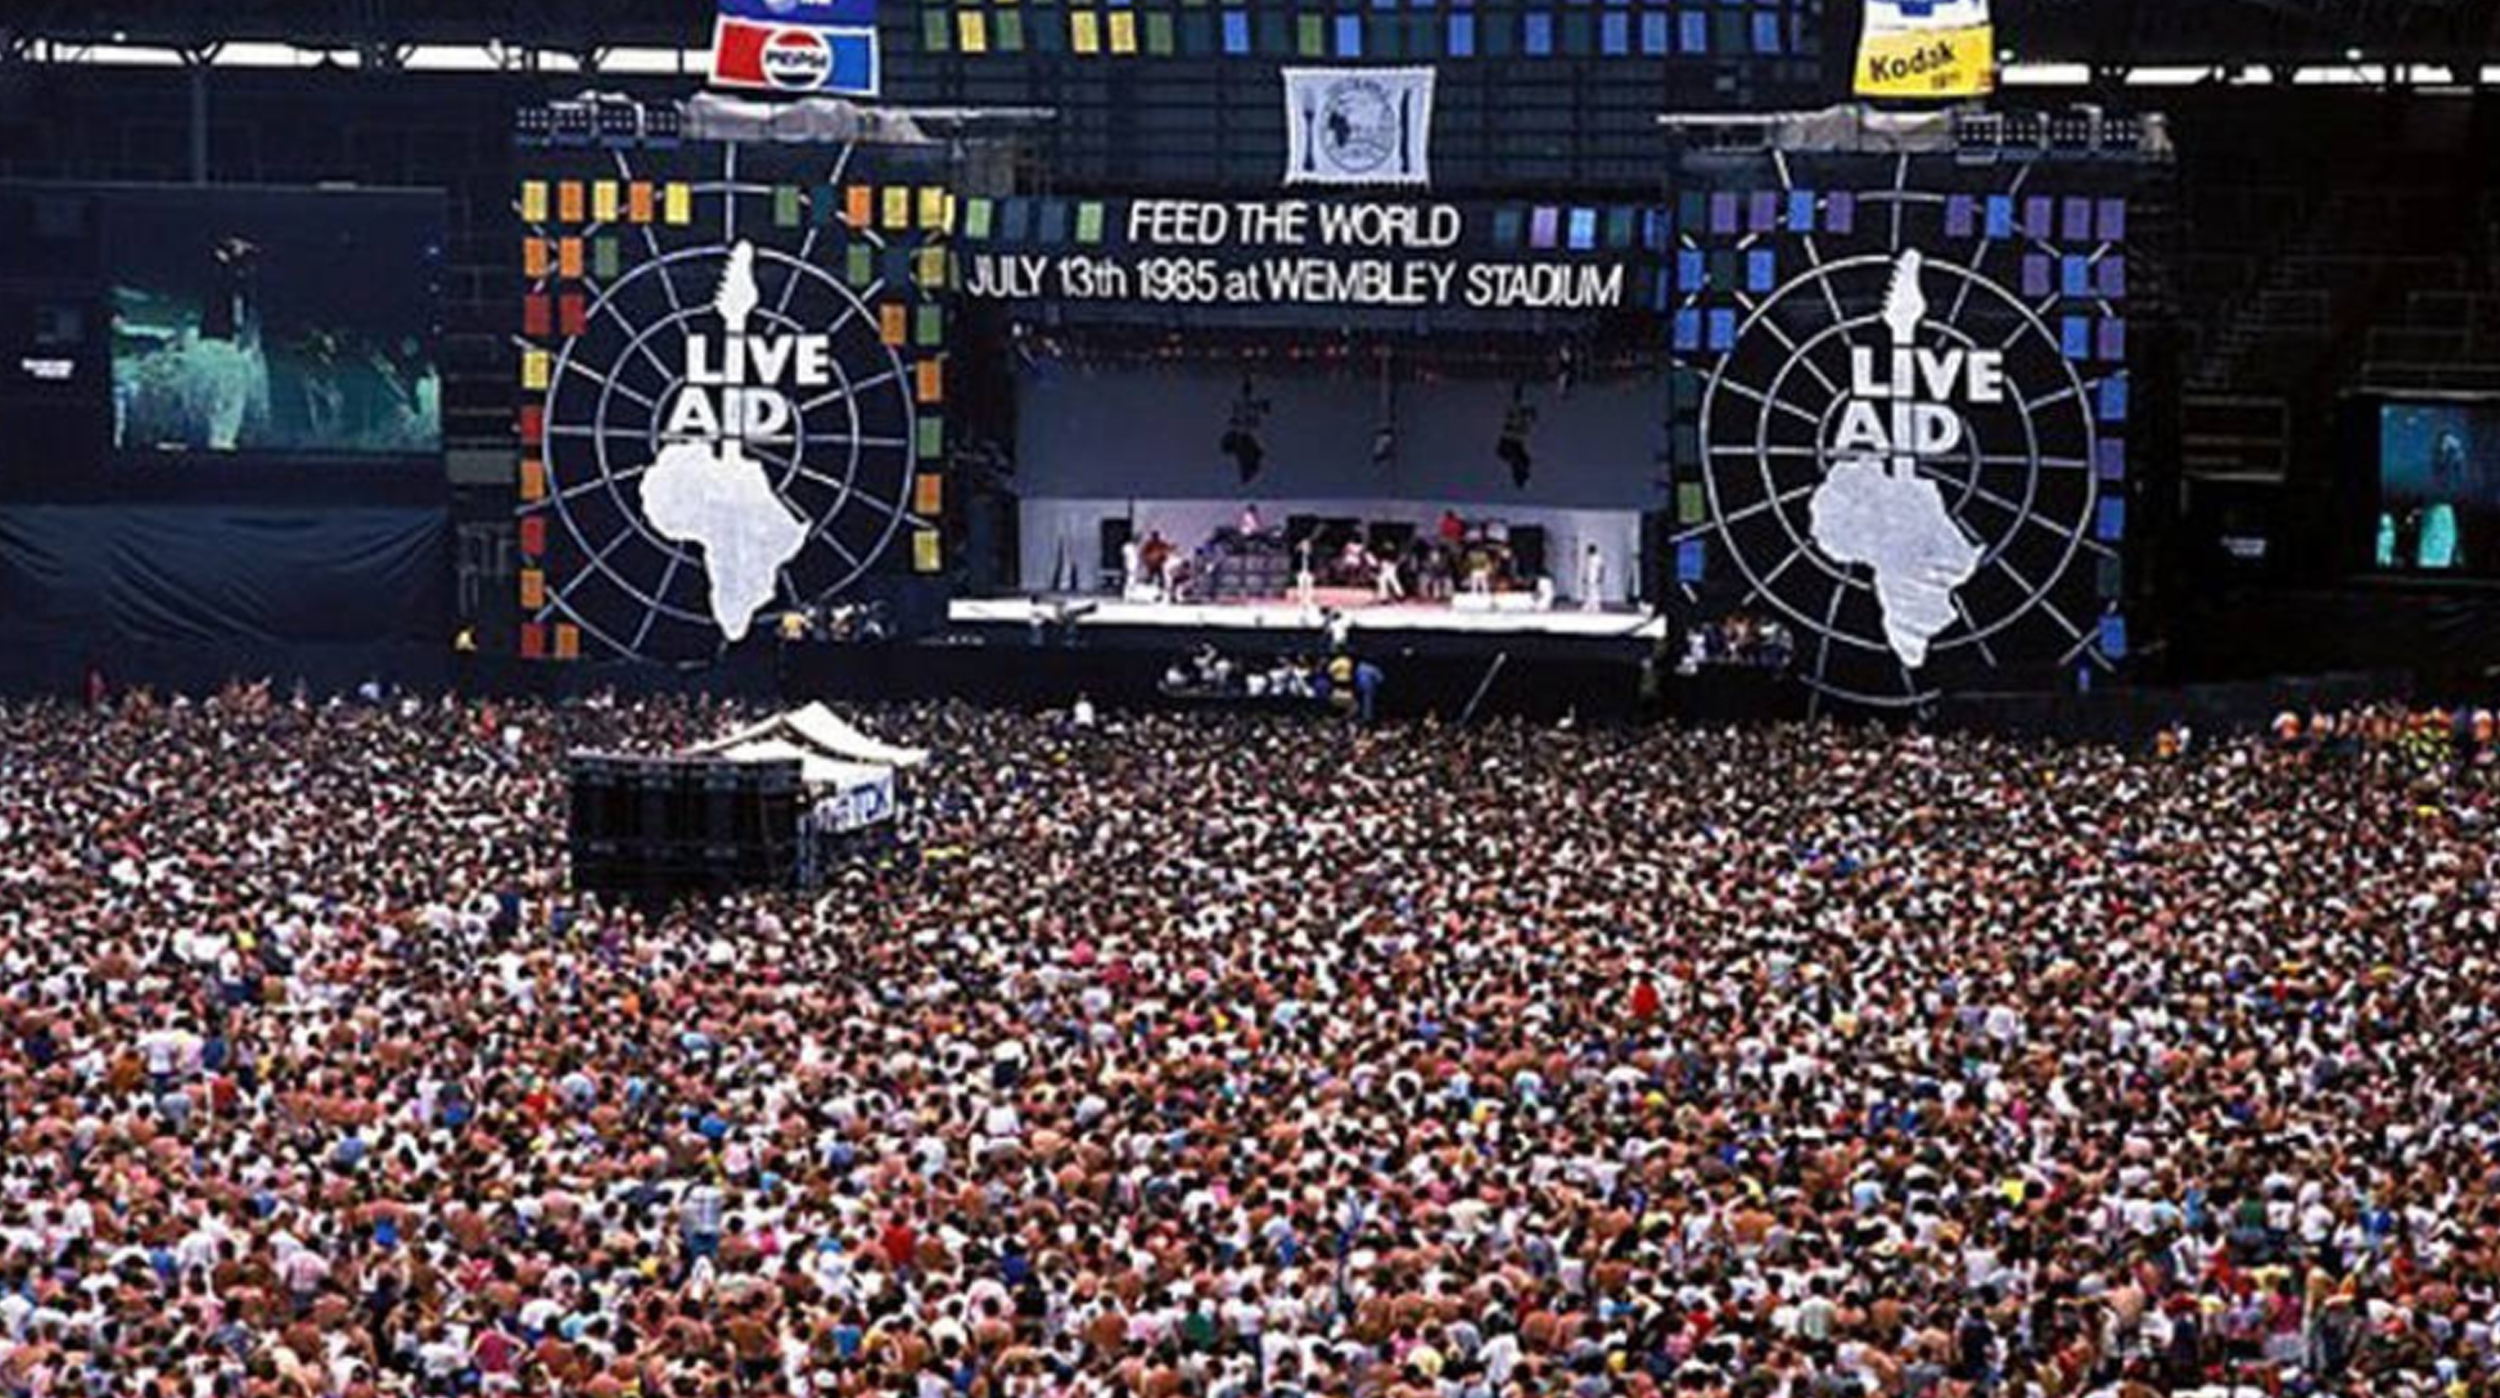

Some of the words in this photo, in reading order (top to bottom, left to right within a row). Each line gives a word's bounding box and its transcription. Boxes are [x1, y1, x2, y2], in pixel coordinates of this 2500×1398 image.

[1870, 41, 1955, 82] Kodak
[1128, 200, 1228, 244] FEED
[1236, 201, 1308, 244] THE
[1319, 203, 1460, 247] WORLD
[967, 254, 1048, 297] JULY
[1058, 255, 1128, 298] 13th
[1137, 257, 1219, 301] 1985
[1224, 263, 1262, 301] at
[1263, 258, 1457, 304] WEMBLEY
[1464, 262, 1623, 307] STADIUM
[686, 334, 830, 385] LIVE
[1852, 346, 2003, 402] LIVE
[662, 387, 789, 438] AID
[1829, 401, 1962, 453] AID
